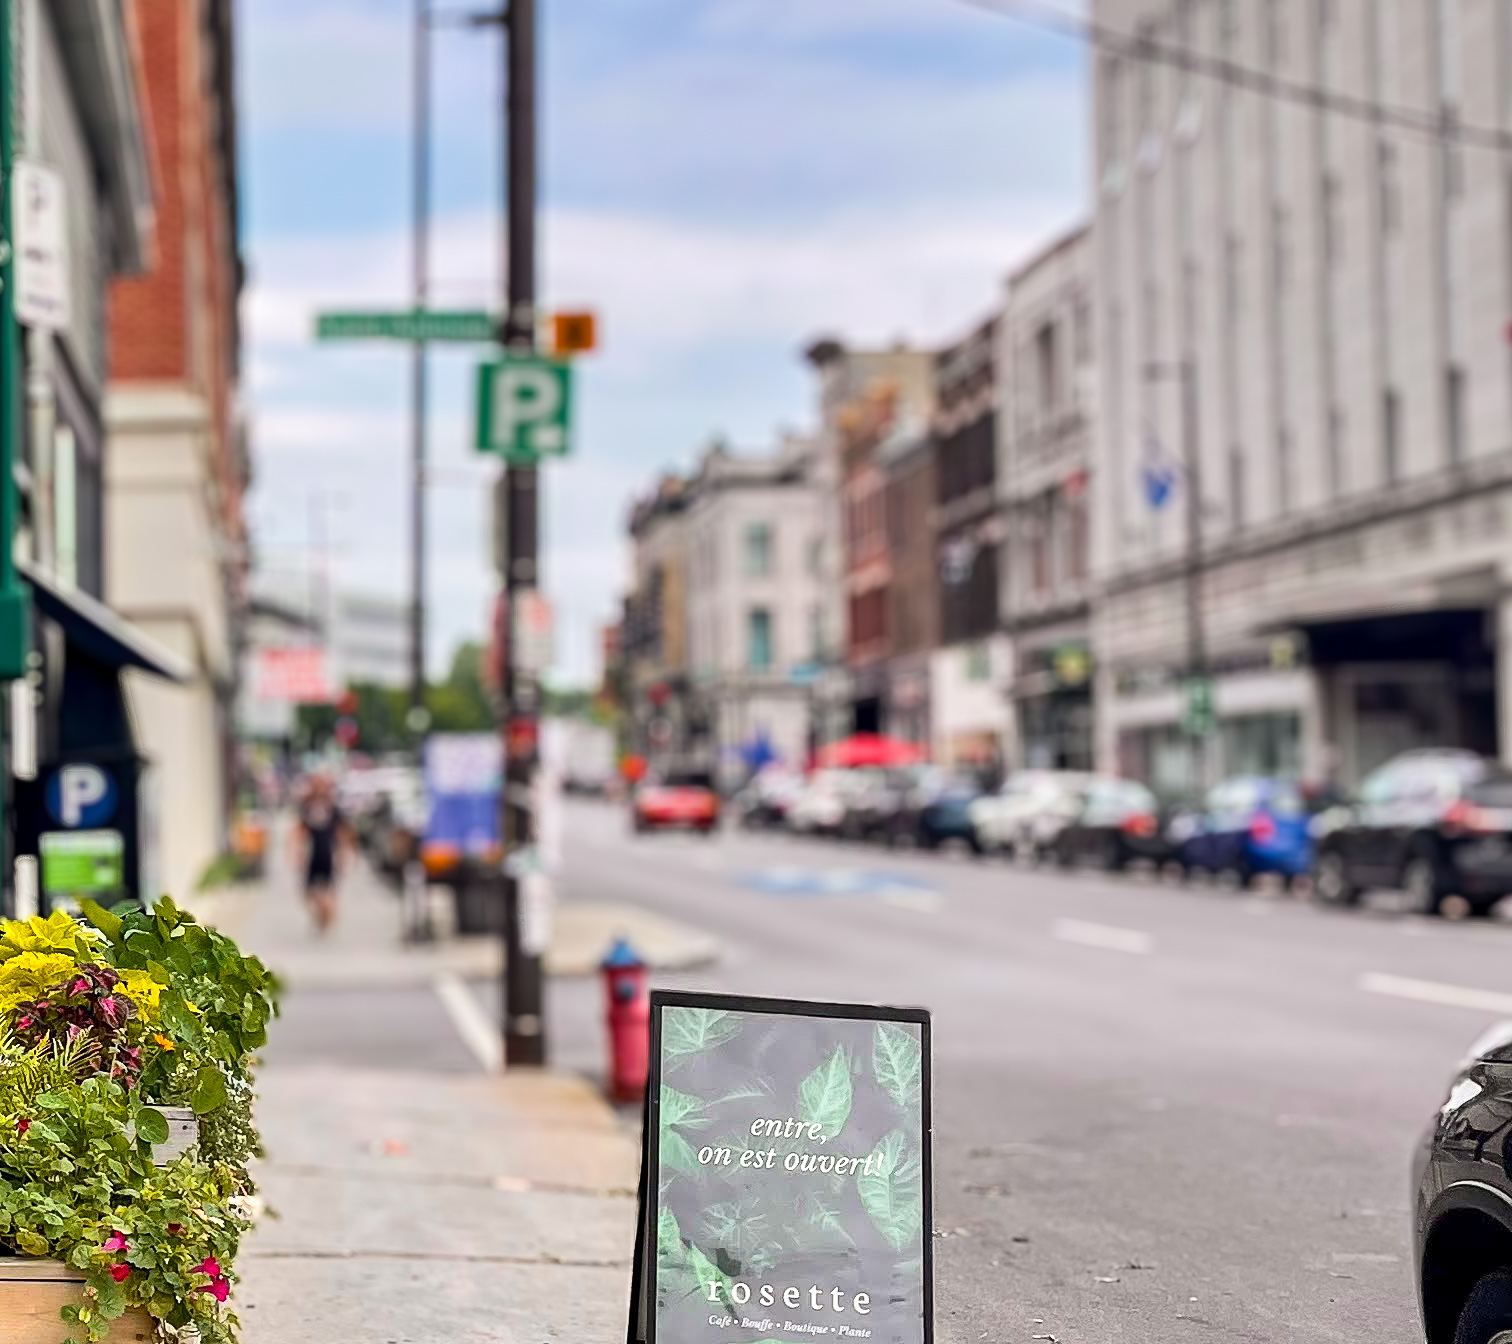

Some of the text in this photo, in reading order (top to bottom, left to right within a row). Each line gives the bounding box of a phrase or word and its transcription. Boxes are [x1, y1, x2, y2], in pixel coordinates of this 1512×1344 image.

[492, 368, 563, 448] P
[58, 762, 108, 827] P
[751, 1117, 827, 1145] entre,
[697, 1146, 884, 1177] on est ouvert!
[707, 1280, 871, 1314] rosette
[708, 1314, 872, 1338] Café Bouffe Boutique Plante
